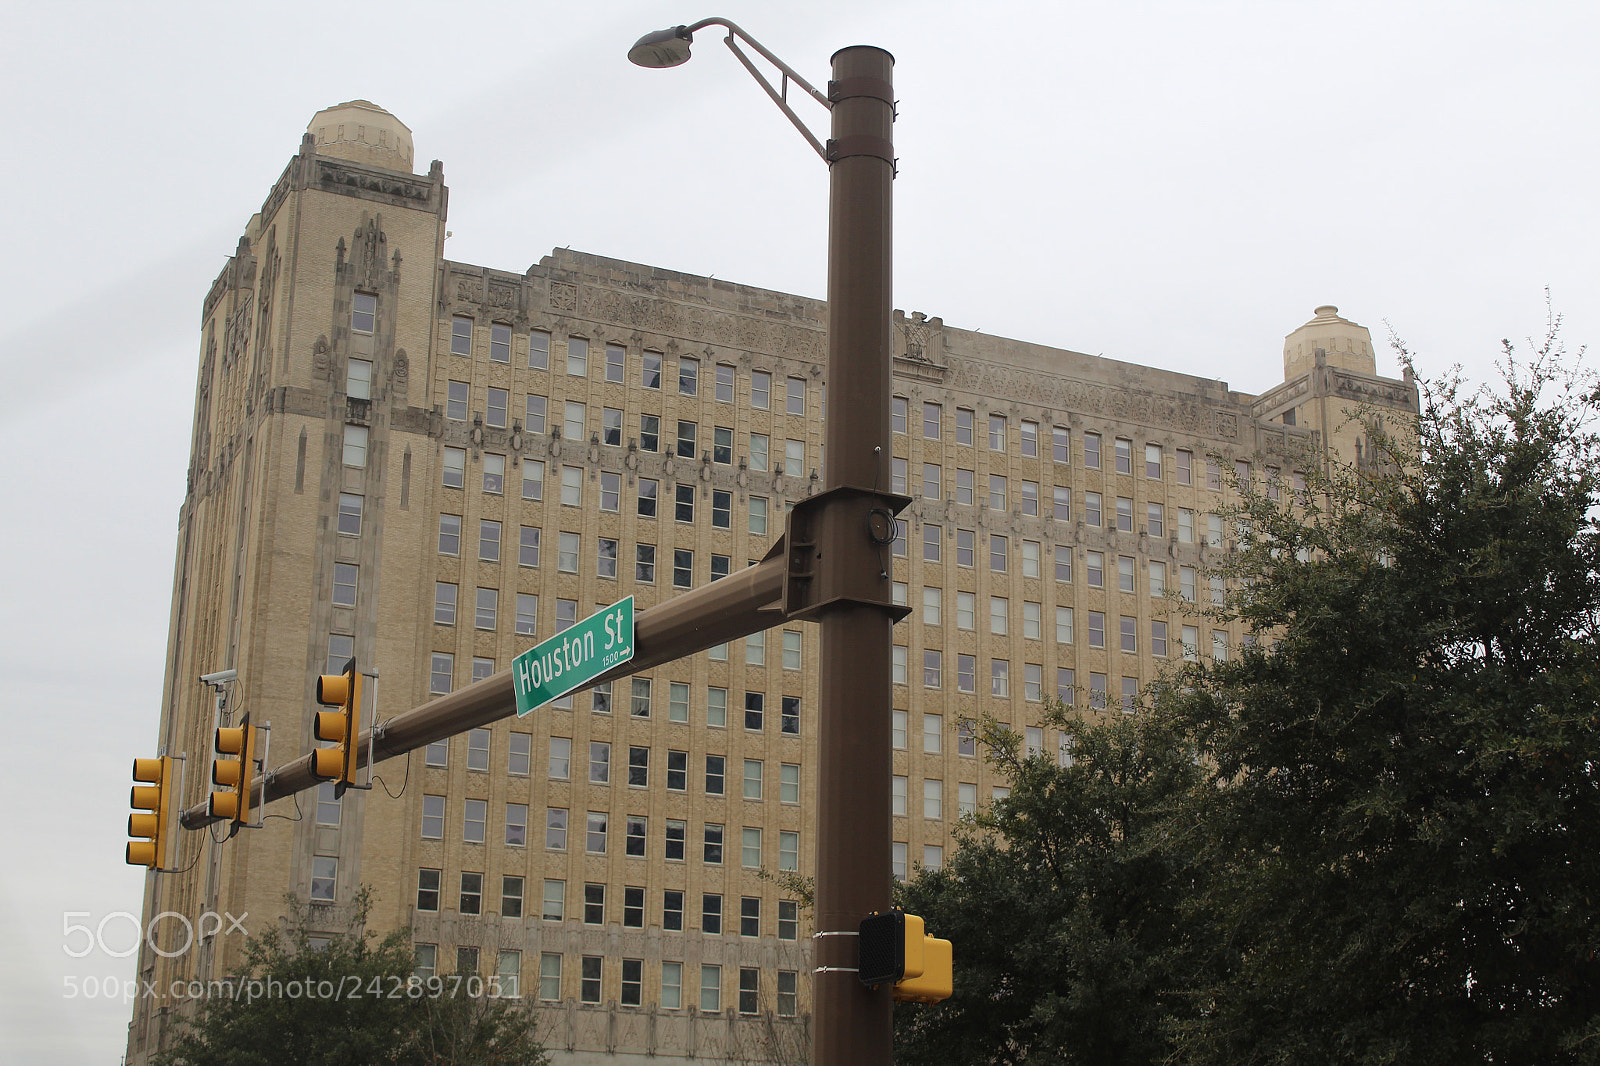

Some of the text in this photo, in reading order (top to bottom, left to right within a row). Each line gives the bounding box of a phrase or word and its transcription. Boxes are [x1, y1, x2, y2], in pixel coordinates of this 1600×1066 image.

[519, 608, 624, 695] Houston St
[602, 651, 619, 667] 1500
